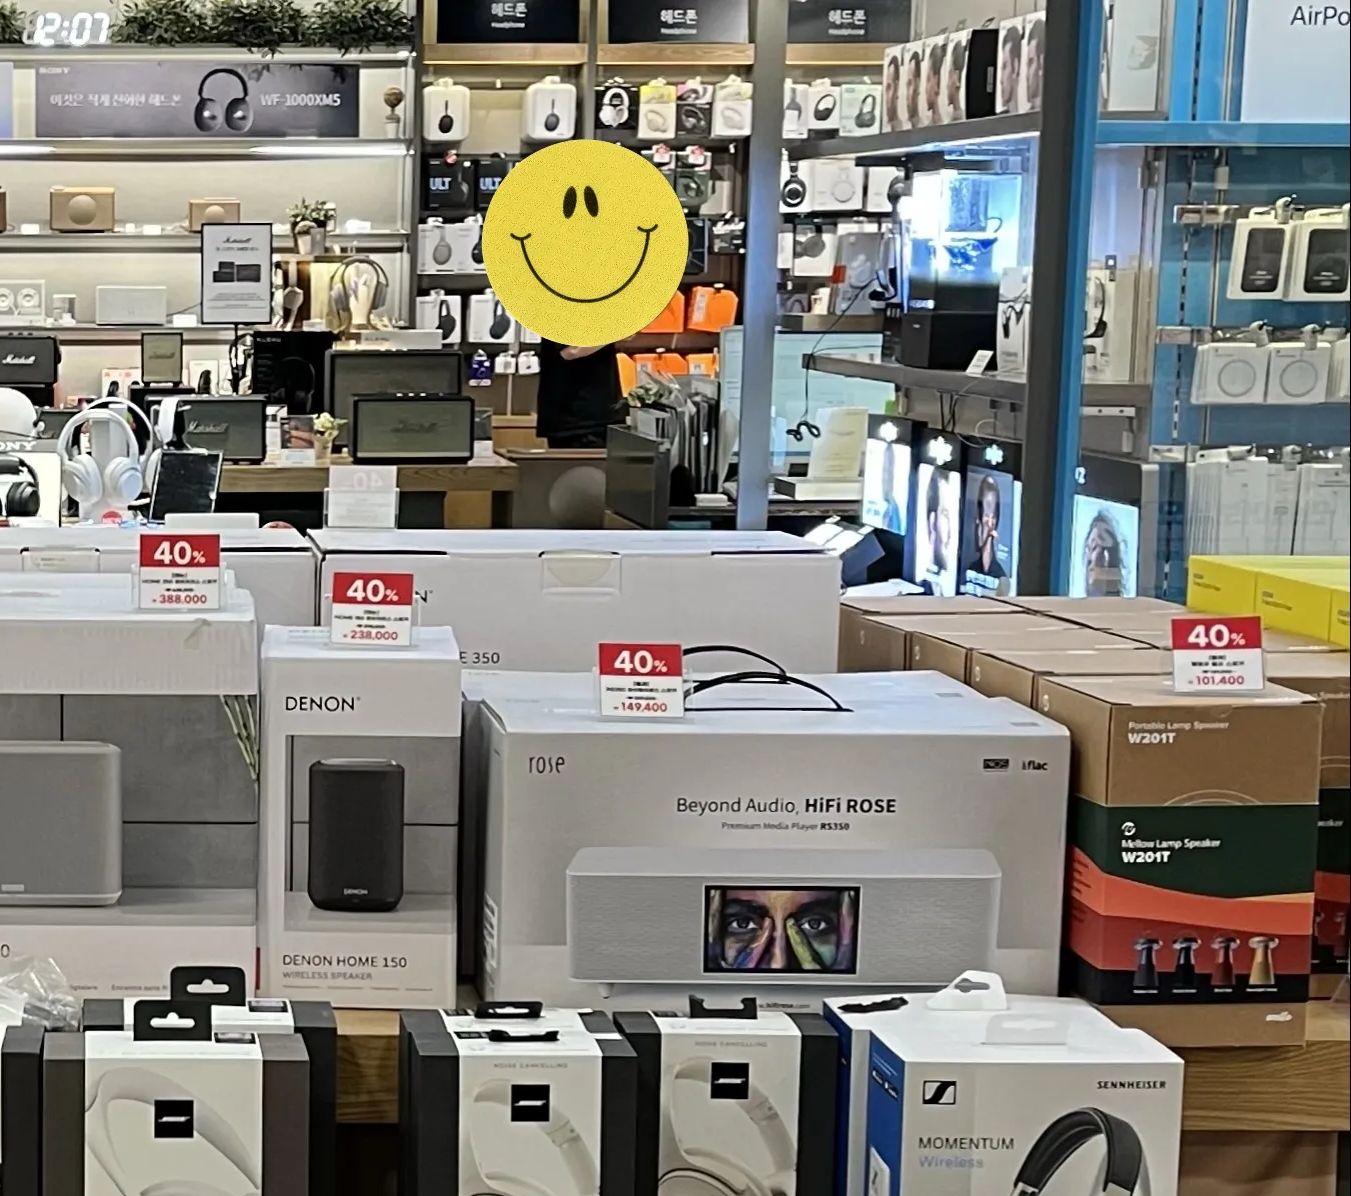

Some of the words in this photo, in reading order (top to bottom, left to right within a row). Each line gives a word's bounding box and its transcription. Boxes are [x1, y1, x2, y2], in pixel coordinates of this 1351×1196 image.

[491, 3, 527, 17] 헤드폰
[661, 9, 698, 24] 헤드폰
[829, 9, 866, 24] 헤드폰
[1290, 5, 1350, 26] AirPo
[34, 12, 110, 46] 12:07
[38, 67, 70, 75] SONY
[50, 93, 84, 107] 이것은
[260, 93, 341, 107] WF-1000XM5
[429, 177, 451, 191] ULT
[1, 354, 36, 365] Marshall
[187, 421, 229, 433] Marshall
[153, 540, 206, 565] 40%
[346, 578, 399, 603] 40%
[1187, 623, 1246, 648] 40%
[472, 652, 500, 665] 350
[613, 649, 668, 674] 40%
[285, 696, 355, 711] DENON
[1128, 721, 1165, 730] Portable
[1167, 721, 1191, 731] Lamp
[1193, 720, 1229, 730] Speaker
[1128, 732, 1176, 744] W201T
[528, 755, 566, 775] rose
[676, 797, 741, 816] Beyond
[745, 797, 799, 816] Audio,
[804, 797, 841, 814] HiFi
[846, 798, 897, 814] ROSE
[721, 821, 761, 830] Premium
[763, 821, 789, 830] Media
[791, 822, 818, 832] Player
[820, 822, 850, 831] RS350
[1121, 839, 1155, 848] Mellow
[1156, 839, 1182, 850] Lamp
[1183, 838, 1221, 849] Speaker
[1121, 851, 1171, 863] W201T
[282, 954, 333, 967] DENON
[336, 956, 378, 967] HOME
[382, 956, 408, 968] 150
[282, 971, 329, 980] WIRELESS
[330, 972, 373, 981] SPEAKER
[1096, 1080, 1166, 1090] SENNHEISER
[918, 1137, 1014, 1150] MOMENTUM
[918, 1155, 984, 1168] Wireless
